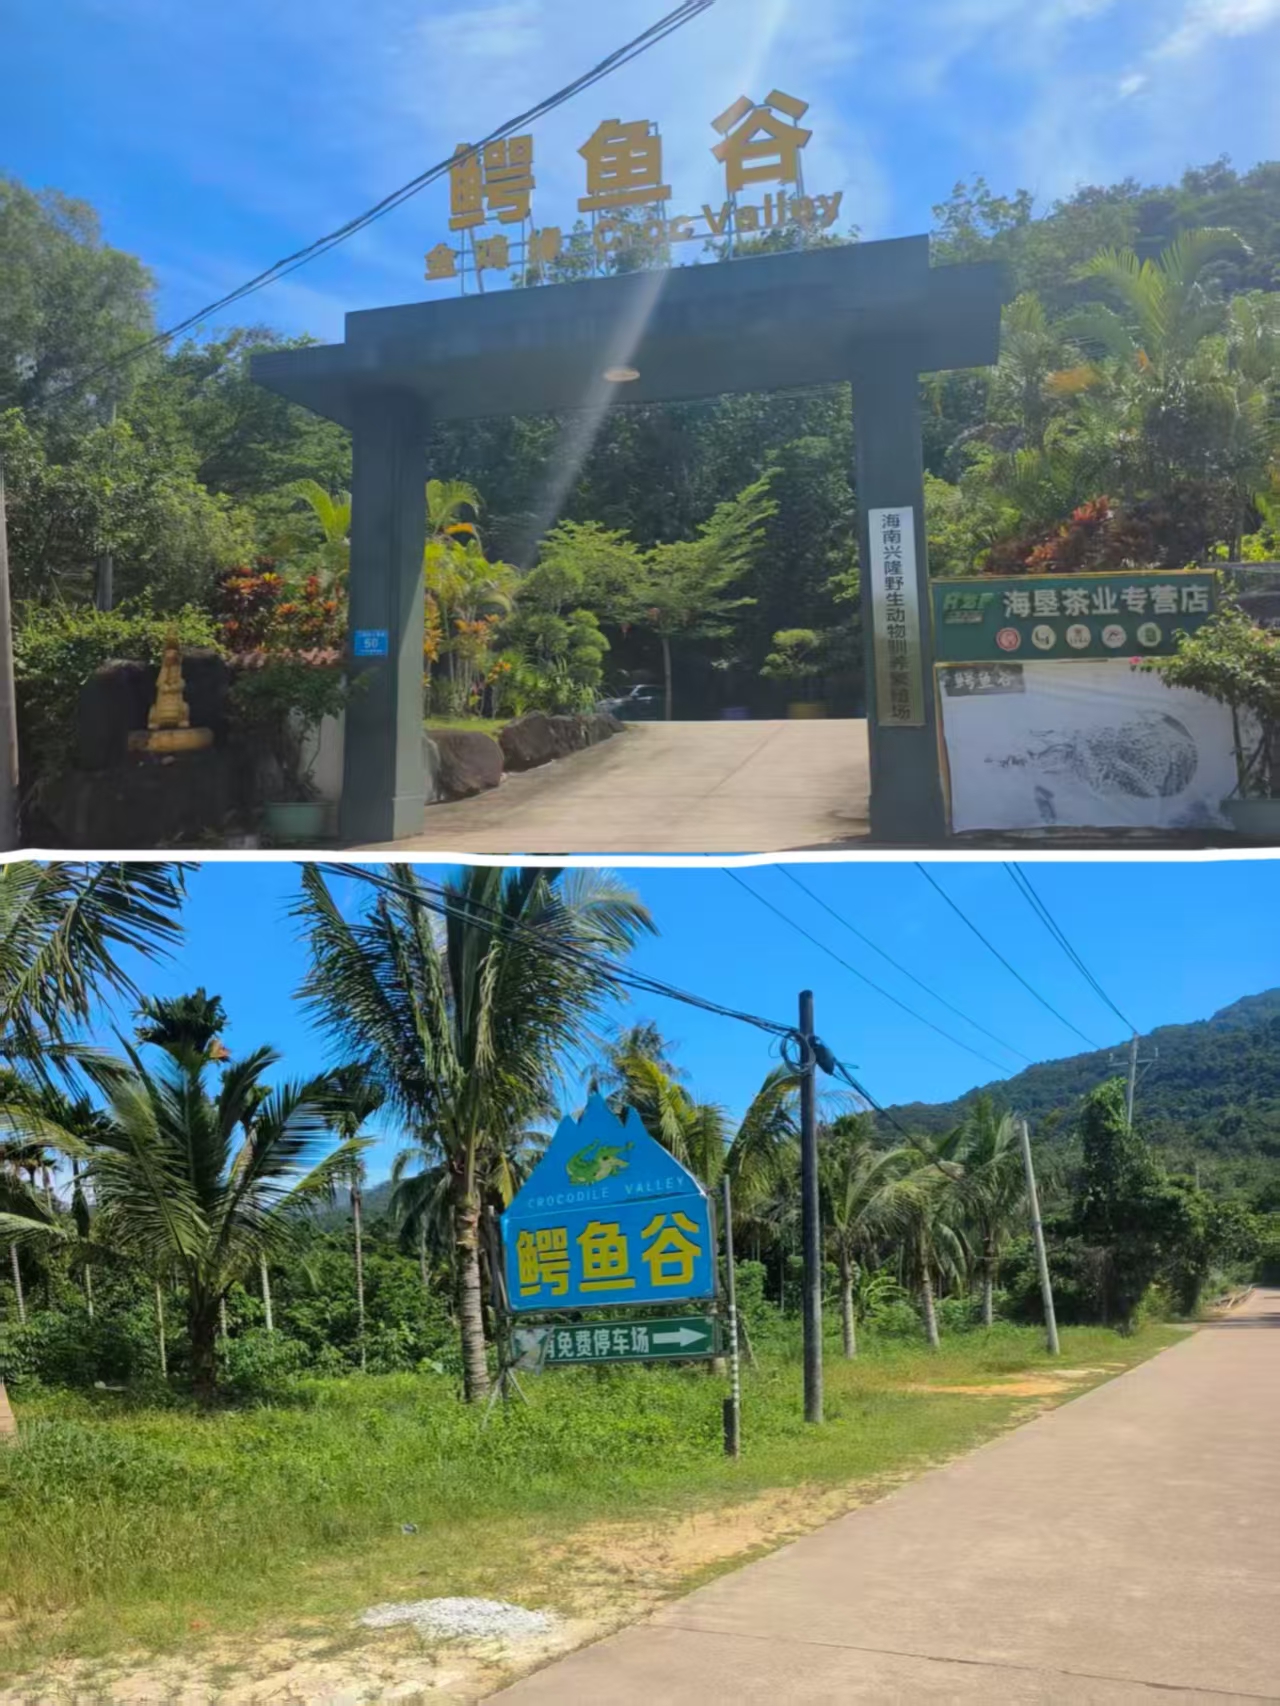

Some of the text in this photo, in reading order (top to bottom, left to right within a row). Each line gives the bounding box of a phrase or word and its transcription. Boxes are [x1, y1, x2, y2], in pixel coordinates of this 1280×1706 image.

[449, 89, 813, 231] 鳄鱼谷
[702, 190, 843, 236] Valley
[1003, 584, 1209, 618] 海垦茶业专营店
[364, 638, 379, 649] 50
[528, 1176, 685, 1209] CROCODILE VALLEY
[516, 1211, 701, 1297] 鳄鱼谷
